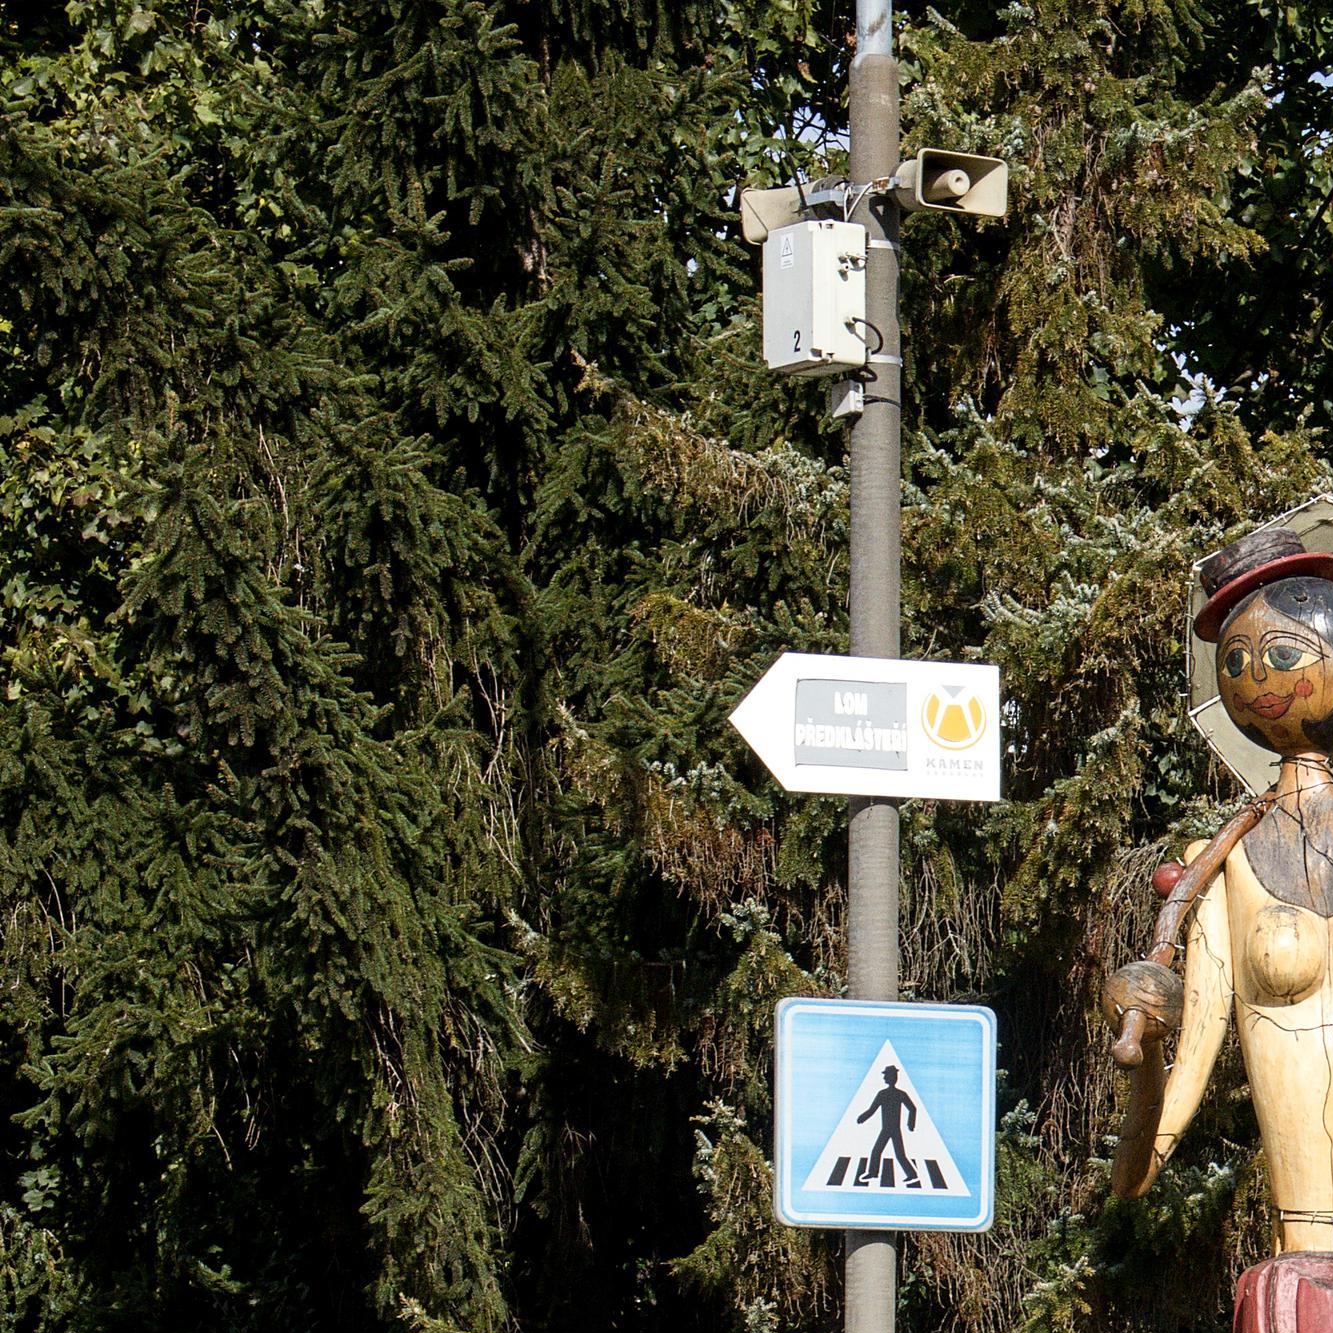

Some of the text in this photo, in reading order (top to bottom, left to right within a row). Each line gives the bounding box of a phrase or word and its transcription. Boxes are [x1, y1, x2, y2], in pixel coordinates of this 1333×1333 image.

[793, 330, 801, 352] 2
[833, 691, 868, 716] LOM
[926, 757, 984, 771] KAMEN
